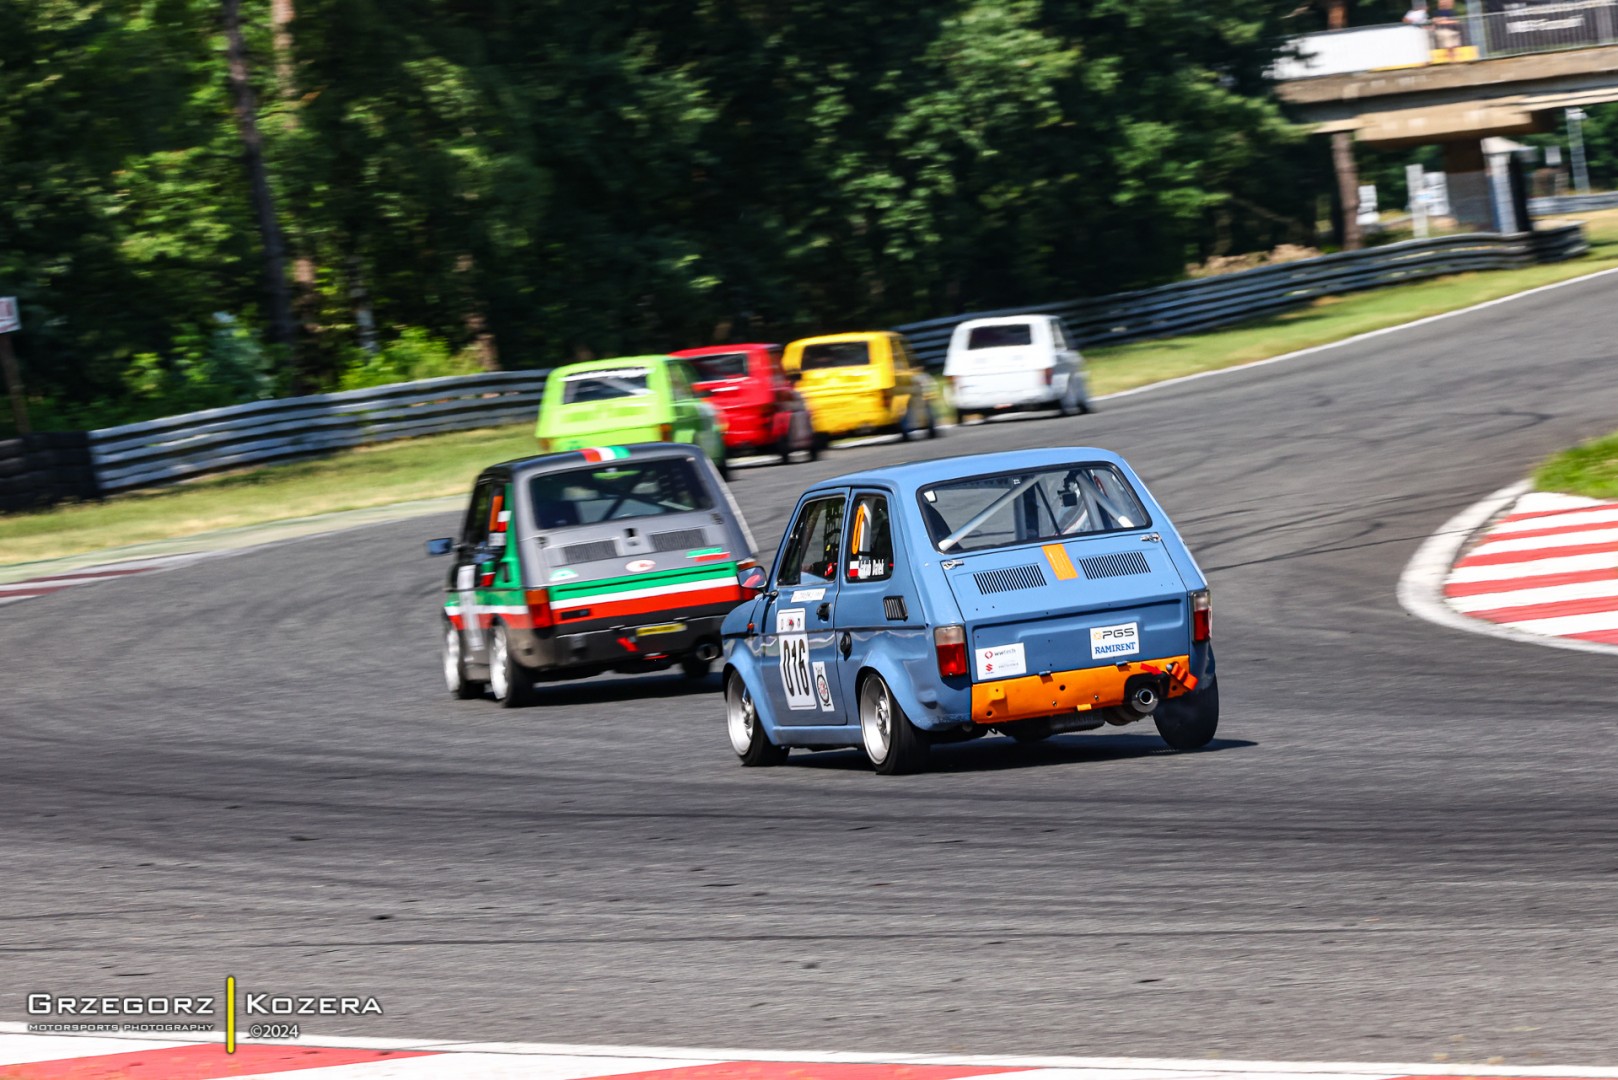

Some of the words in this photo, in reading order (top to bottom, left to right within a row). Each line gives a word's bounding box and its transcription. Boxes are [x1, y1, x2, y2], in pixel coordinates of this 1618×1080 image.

[1102, 627, 1135, 640] PGS
[1094, 641, 1136, 655] RAMIRENT
[783, 639, 809, 696] 016
